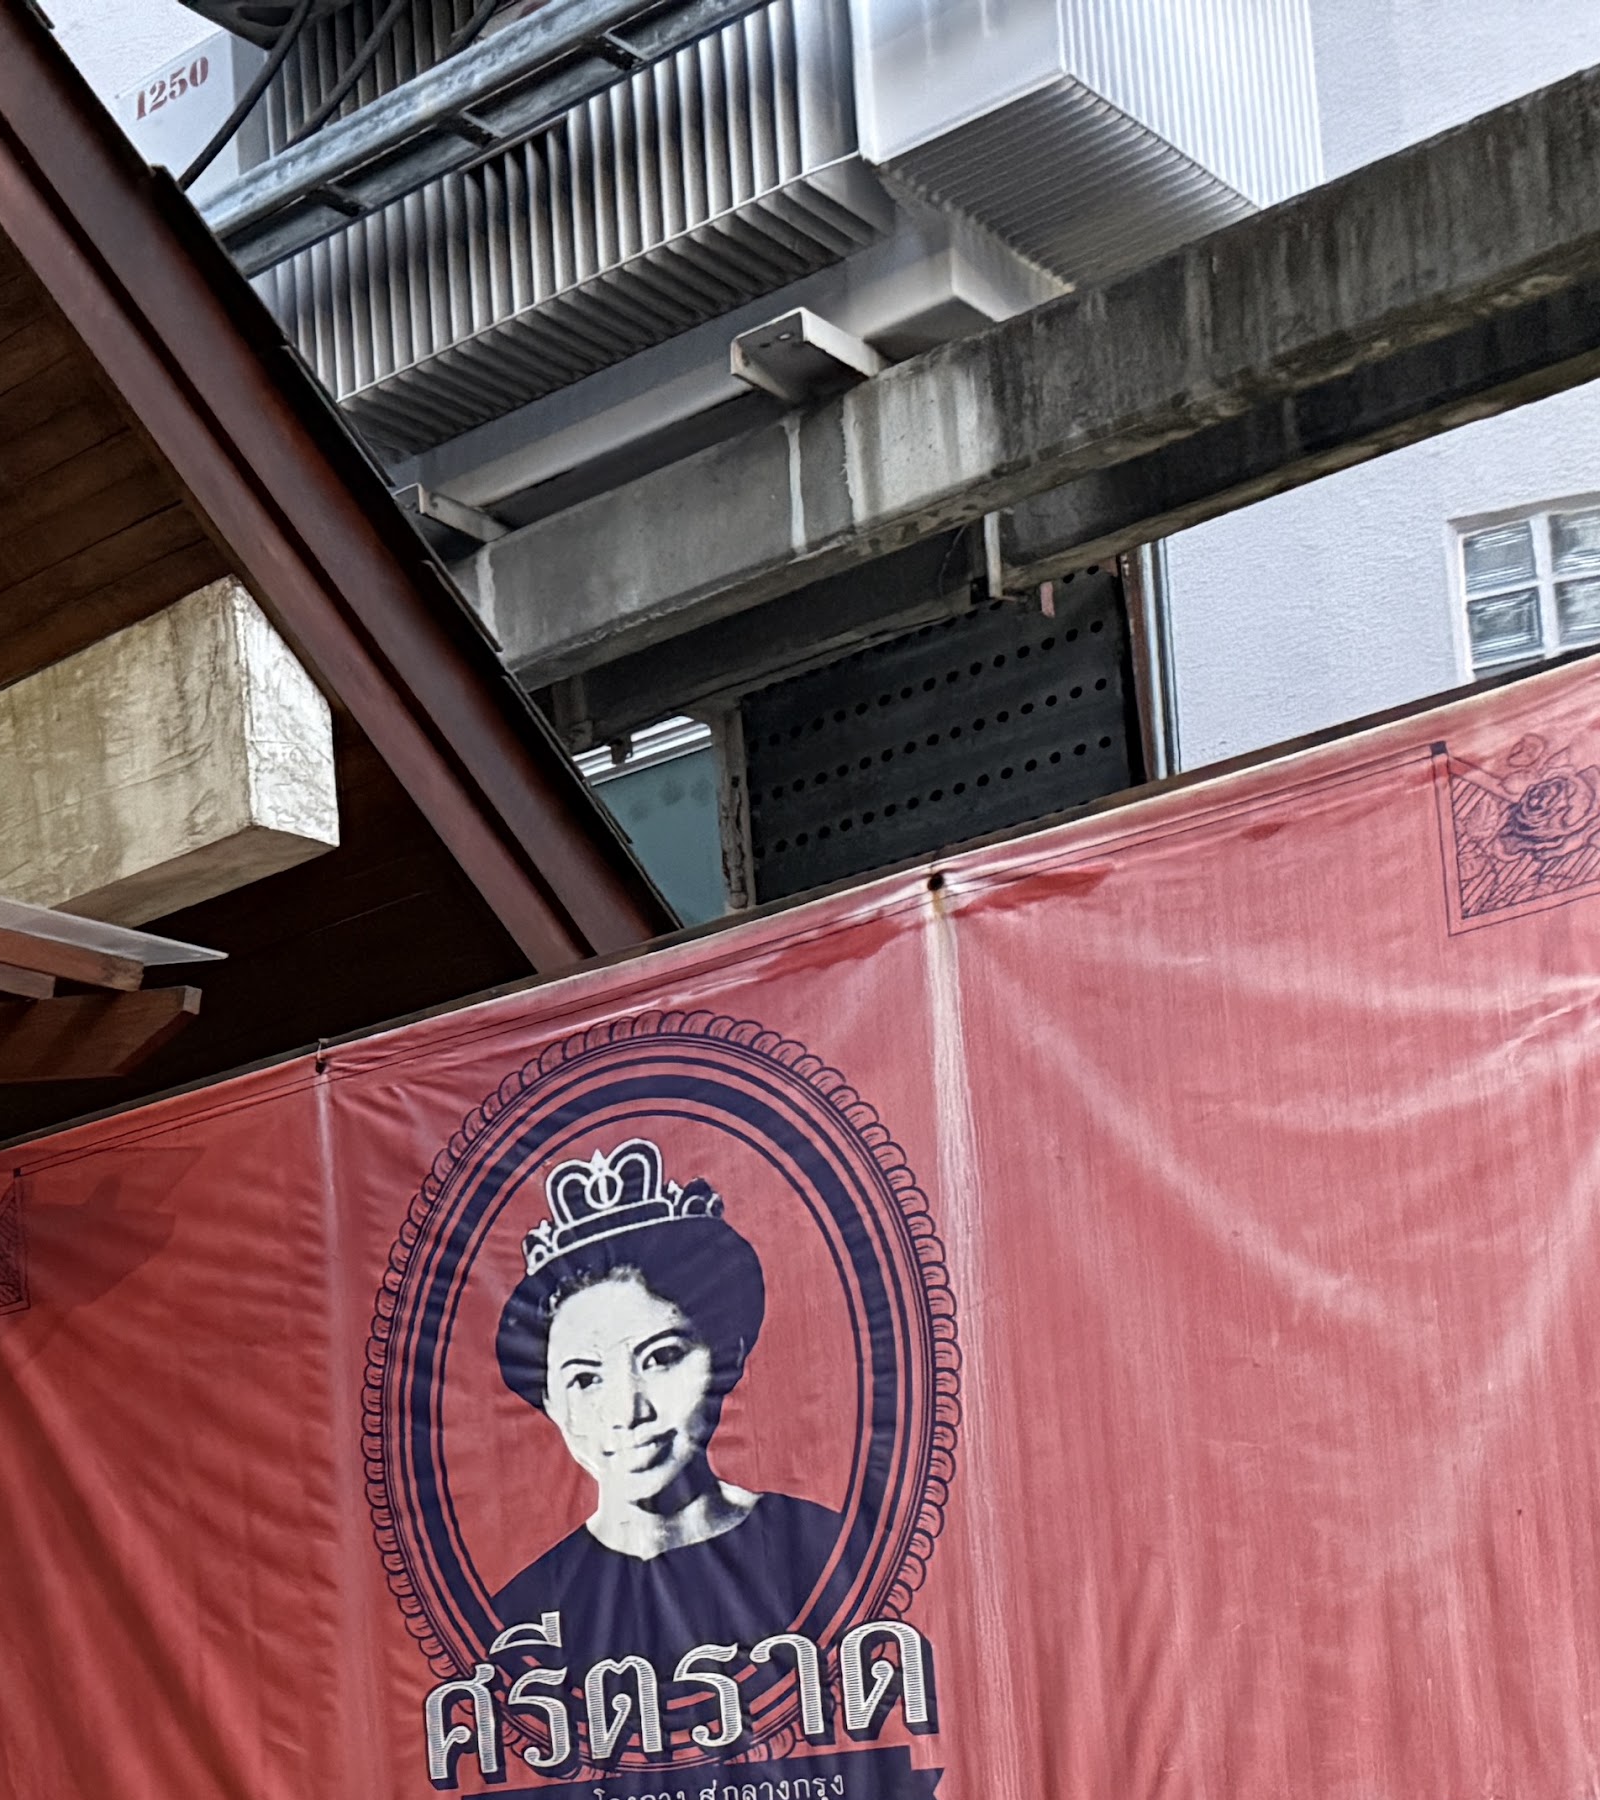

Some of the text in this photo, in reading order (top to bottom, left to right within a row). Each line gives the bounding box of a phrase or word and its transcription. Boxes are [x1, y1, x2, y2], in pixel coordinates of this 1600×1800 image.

[136, 56, 209, 120] 1250
[420, 1610, 937, 1788] ศรีตราด
